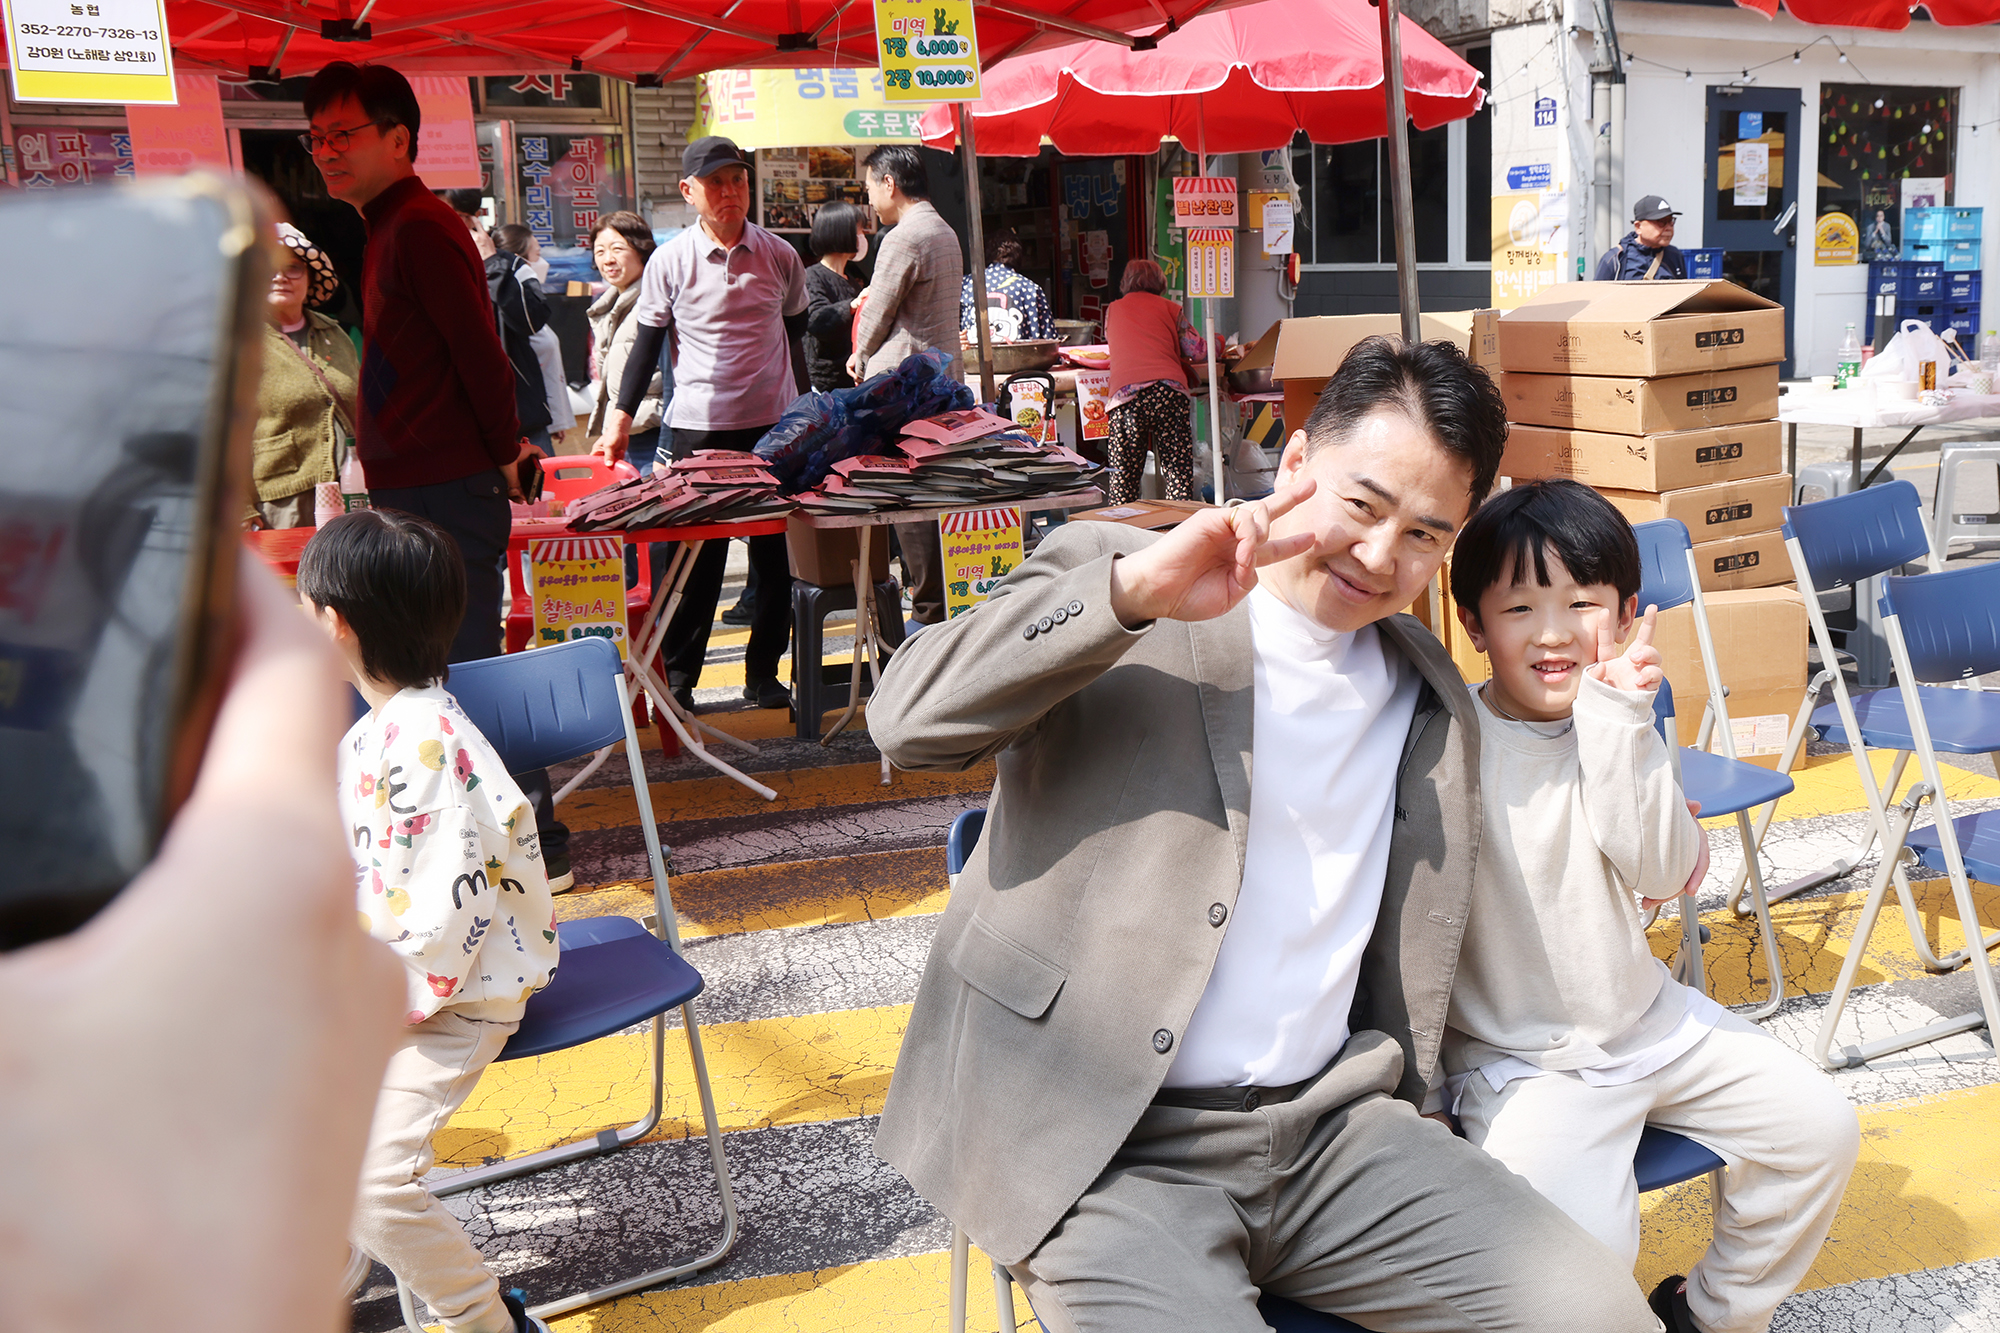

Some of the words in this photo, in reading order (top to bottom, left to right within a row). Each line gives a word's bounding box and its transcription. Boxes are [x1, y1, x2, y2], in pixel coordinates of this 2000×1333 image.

[20, 23, 158, 41] 352-2270-7326-13
[892, 17, 927, 38] 미역
[67, 48, 110, 61] (노해랑
[113, 50, 156, 62] 상인회)
[883, 37, 908, 58] 1장
[885, 69, 912, 90] 2장
[1537, 110, 1554, 126] 114
[1176, 199, 1234, 216] 별난찬방
[1507, 251, 1541, 265] 함께밥상
[1494, 270, 1555, 297] 한식뷔페
[957, 565, 984, 580] 미역
[949, 581, 969, 597] 1장
[540, 627, 565, 642] 1kg
